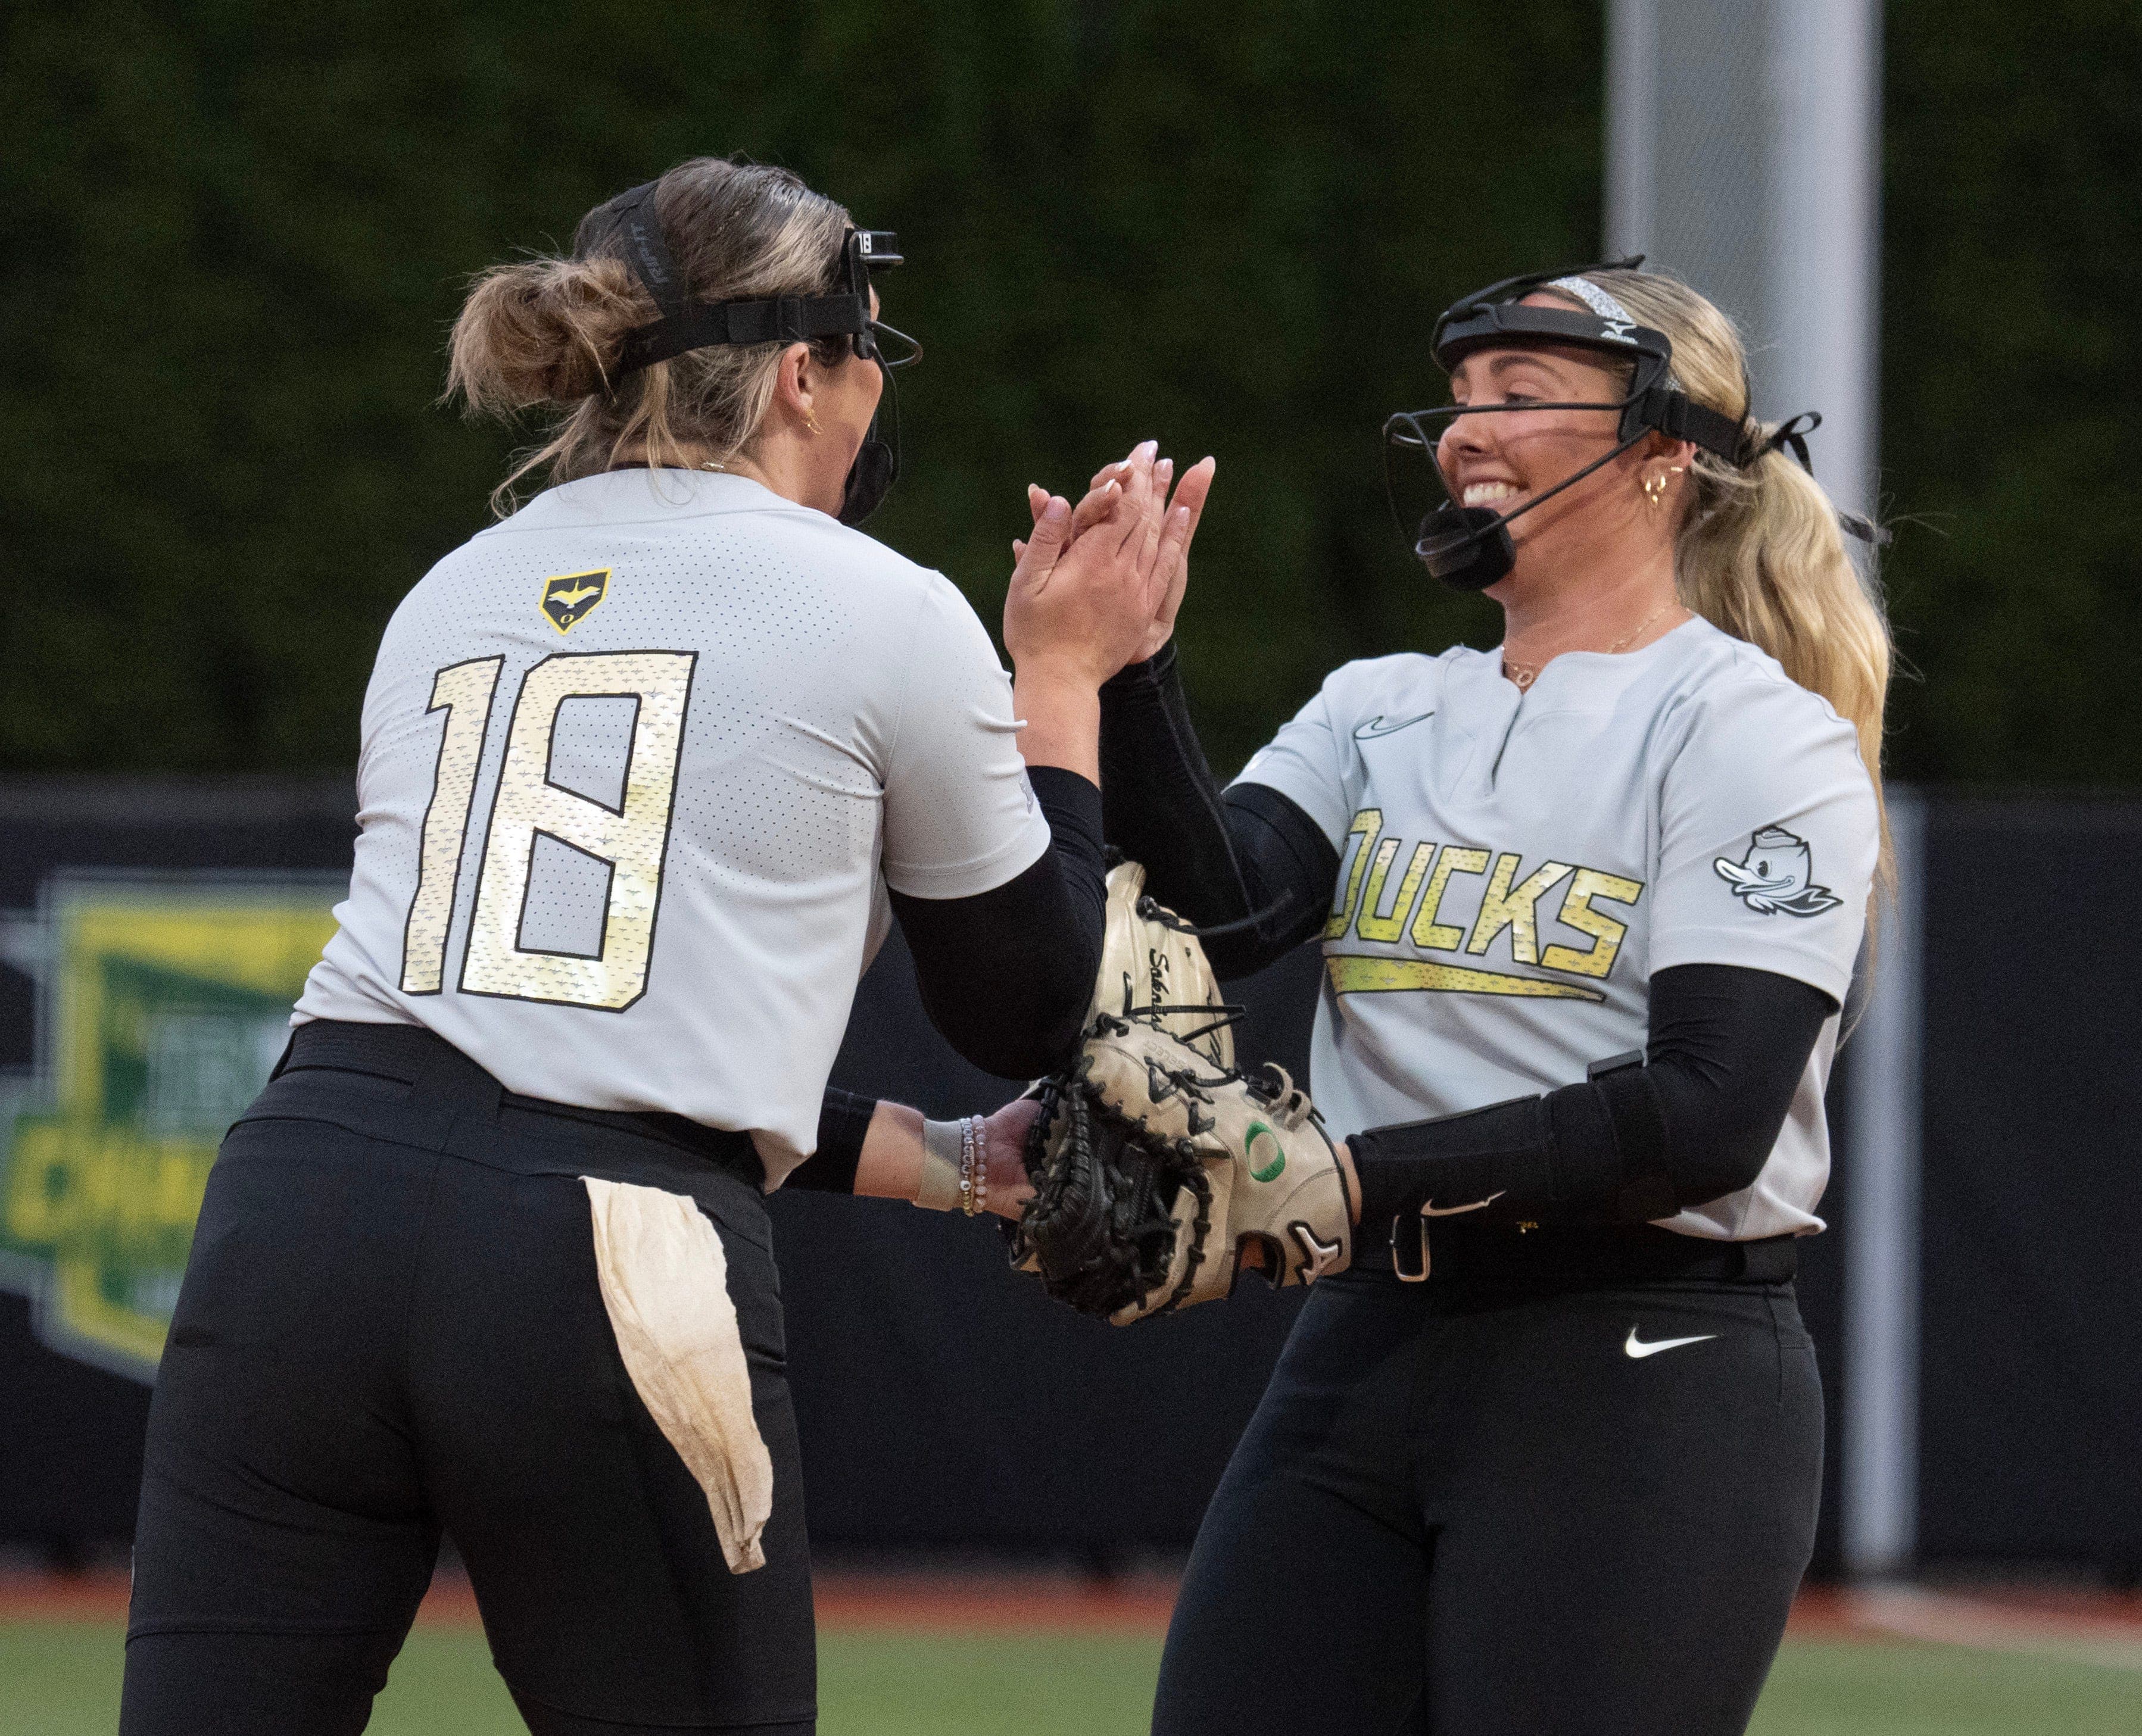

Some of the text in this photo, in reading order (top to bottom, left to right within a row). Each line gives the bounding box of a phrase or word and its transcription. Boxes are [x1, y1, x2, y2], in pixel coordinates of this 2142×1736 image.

[859, 233, 872, 254] 18
[560, 614, 574, 624] O
[399, 651, 699, 1013] 18
